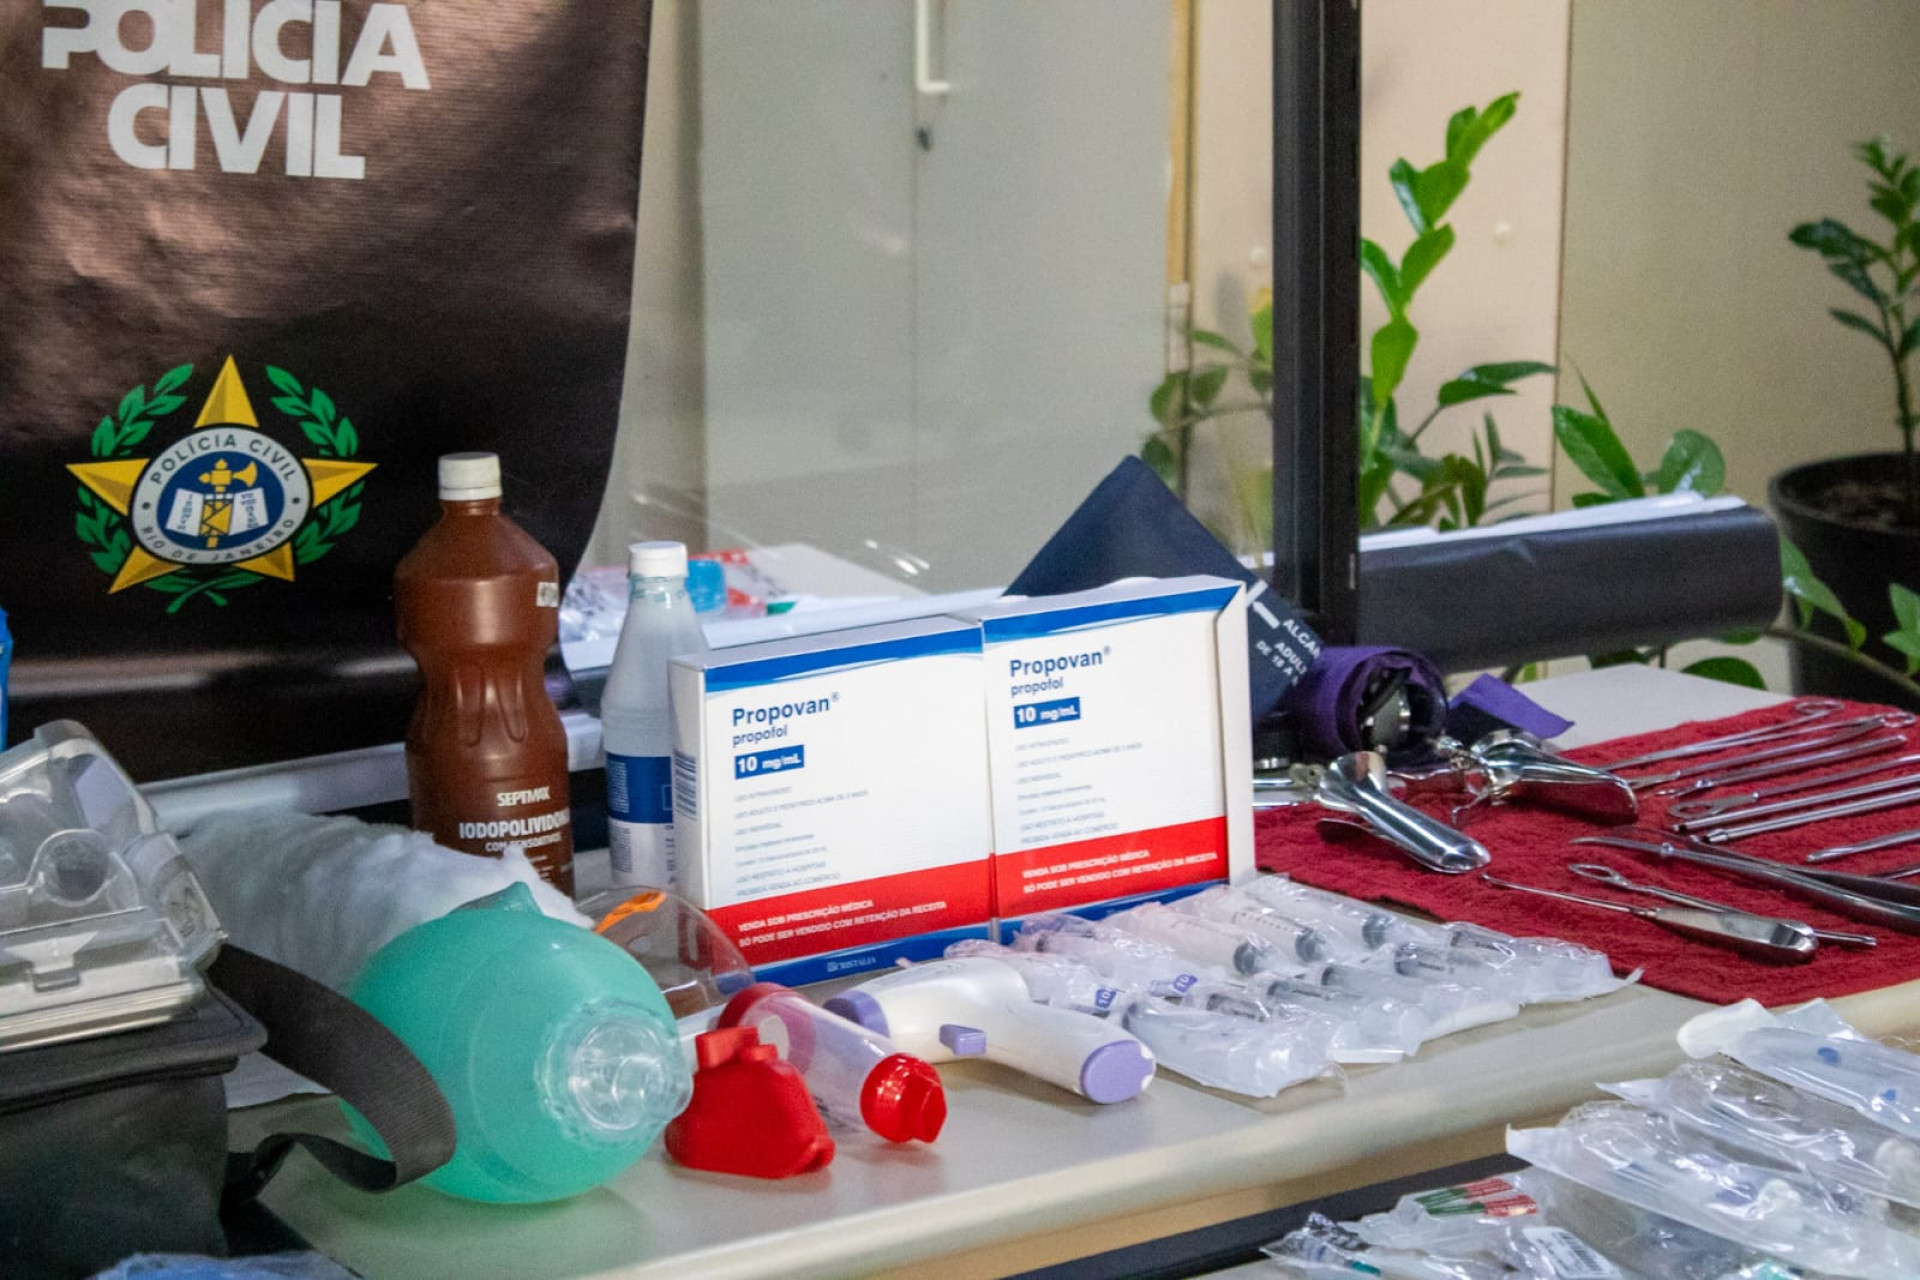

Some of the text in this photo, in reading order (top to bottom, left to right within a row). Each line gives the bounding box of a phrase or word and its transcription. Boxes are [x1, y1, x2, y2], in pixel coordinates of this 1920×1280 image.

[108, 82, 366, 180] CIVIL
[249, 439, 296, 482] CIVIL
[142, 519, 295, 562] RIO DE JANEIRO
[1011, 677, 1064, 699] propofol
[1017, 704, 1079, 724] 10 mg/mL
[732, 724, 788, 749] propofol
[738, 752, 802, 774] 10 mg/mL
[1050, 863, 1068, 874] SOB
[738, 919, 767, 932] VENDA
[767, 915, 786, 927] SOB
[786, 905, 841, 923] PRESCRIÇÃO
[752, 933, 776, 945] PODE
[776, 929, 794, 940] SER
[795, 922, 833, 937] VENDIDO
[833, 918, 853, 930] COM
[898, 907, 912, 917] DA
